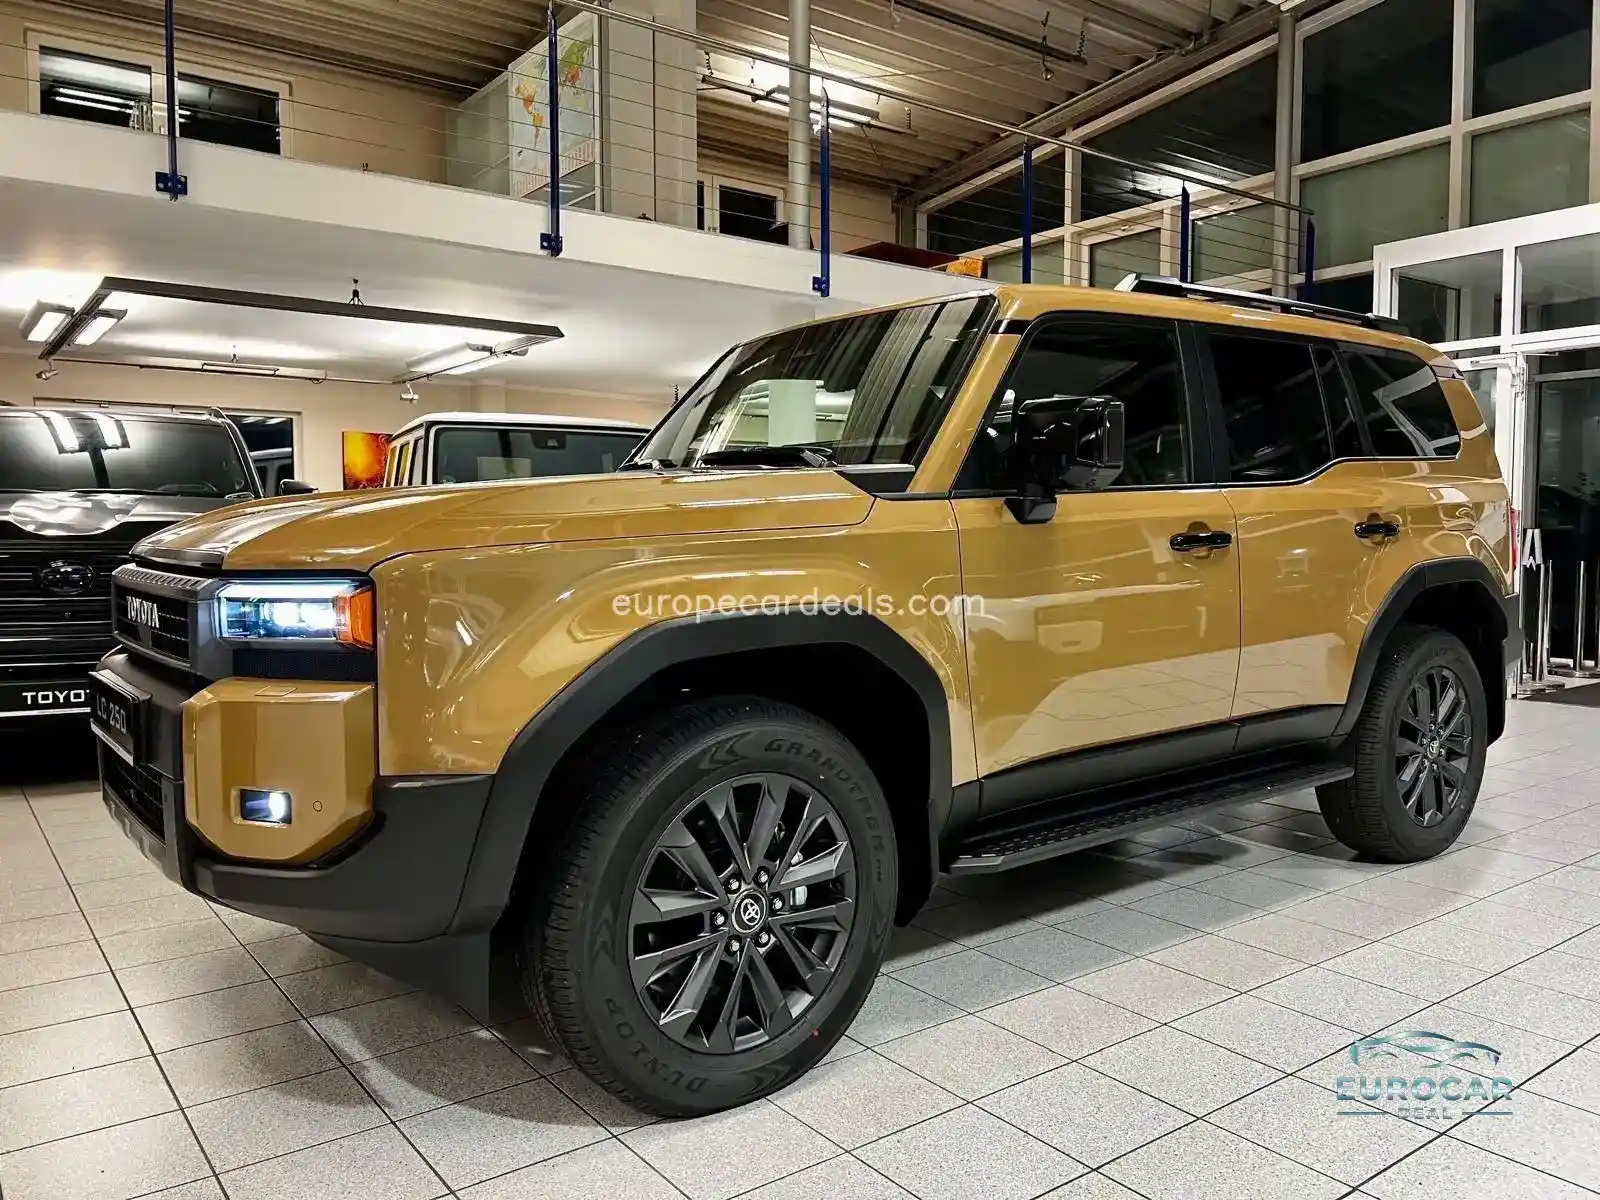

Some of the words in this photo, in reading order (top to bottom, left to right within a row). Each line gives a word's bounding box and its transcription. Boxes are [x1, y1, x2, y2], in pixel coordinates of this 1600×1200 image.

[126, 596, 160, 629] TOYOTA
[22, 689, 91, 705] TOYO
[97, 693, 107, 720] LC
[109, 702, 127, 735] 250
[764, 738, 885, 853] GRANDTREK
[605, 998, 710, 1093] DUNLOP
